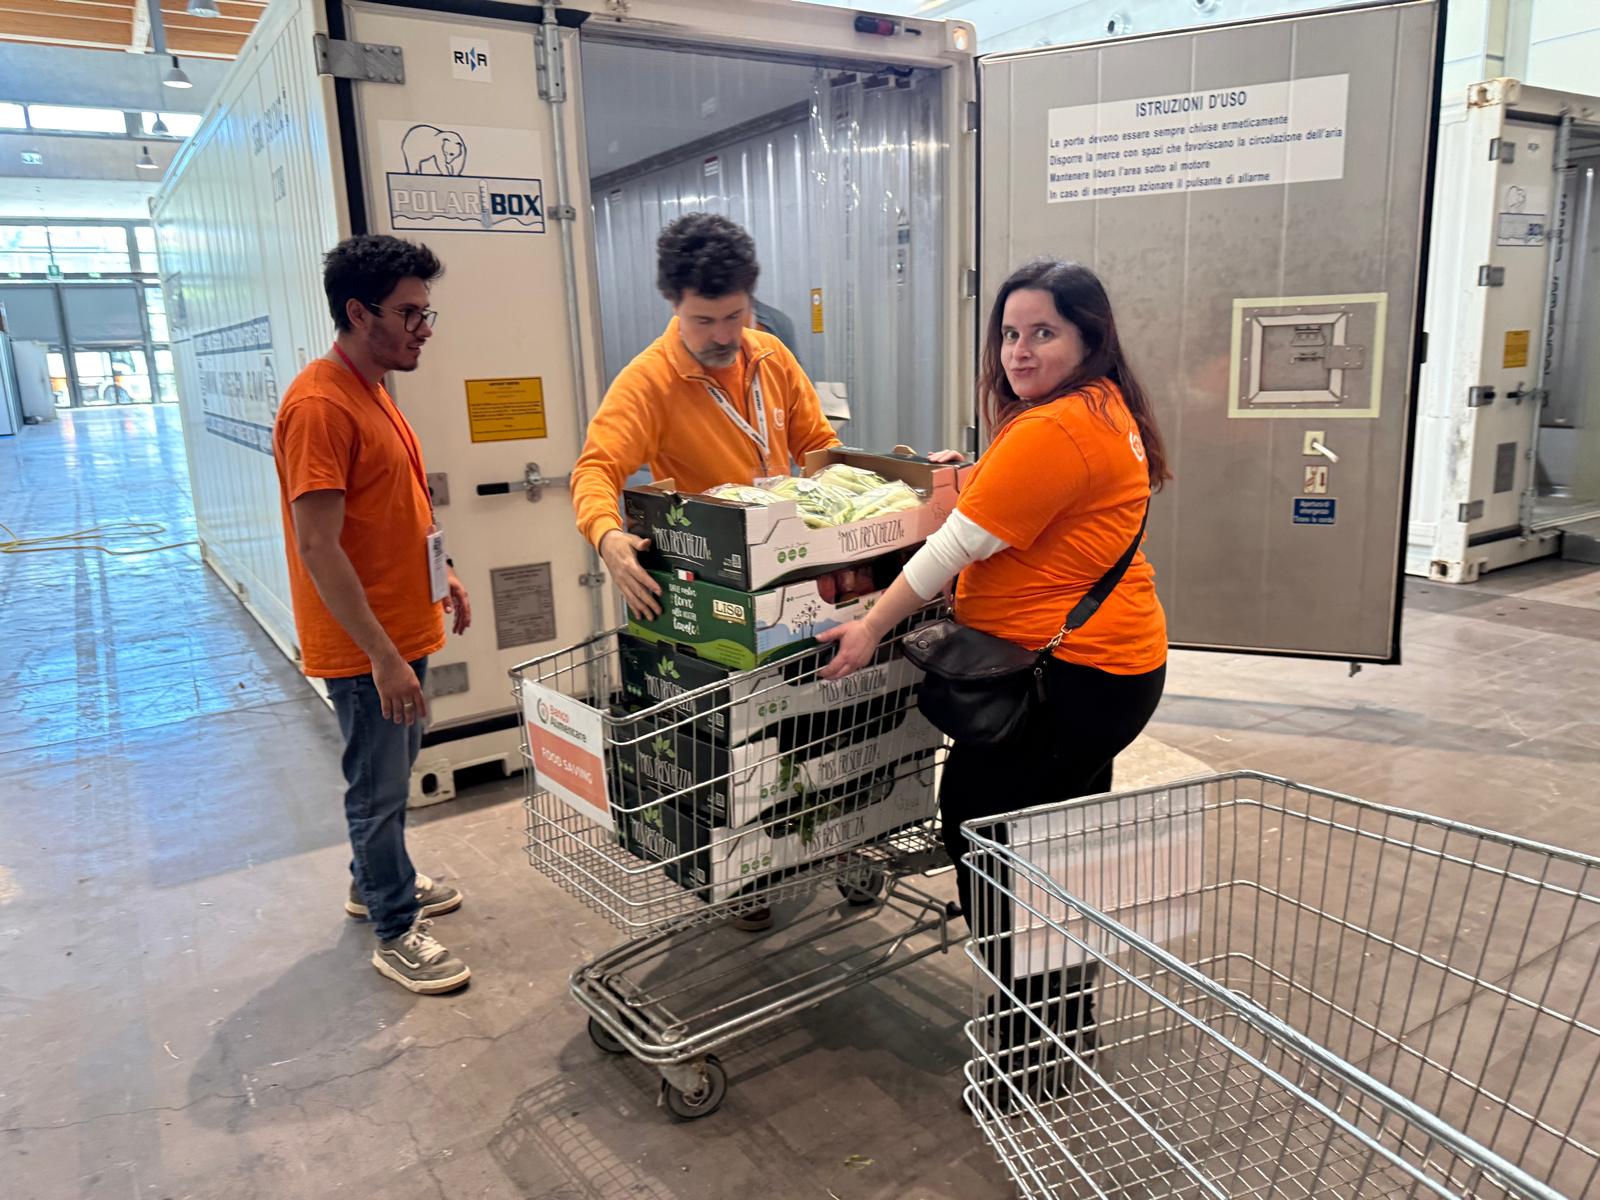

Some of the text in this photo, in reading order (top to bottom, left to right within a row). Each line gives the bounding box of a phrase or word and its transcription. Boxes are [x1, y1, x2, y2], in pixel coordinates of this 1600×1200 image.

[1136, 91, 1248, 117] ISTRUZIONI D'USO
[1050, 115, 1288, 148] Le porte devono essere sempre chiuse ermeticamente
[1050, 127, 1343, 166] Disporre la merce con spazi che favoriscano la circolazione dell'aria
[1050, 171, 1089, 182] Mantenere
[1093, 168, 1116, 178] libera
[1119, 166, 1141, 176] l'area
[1145, 164, 1166, 174] sotto
[1181, 160, 1210, 171] motore
[1050, 190, 1057, 199] In
[1060, 189, 1078, 199] caso
[1081, 186, 1089, 196] di
[1093, 184, 1135, 196] emergenza
[1138, 180, 1173, 192] azionare
[1185, 175, 1222, 189] pulsante
[1225, 174, 1234, 184] di
[1238, 172, 1270, 184] allarme
[490, 192, 542, 217] BOX
